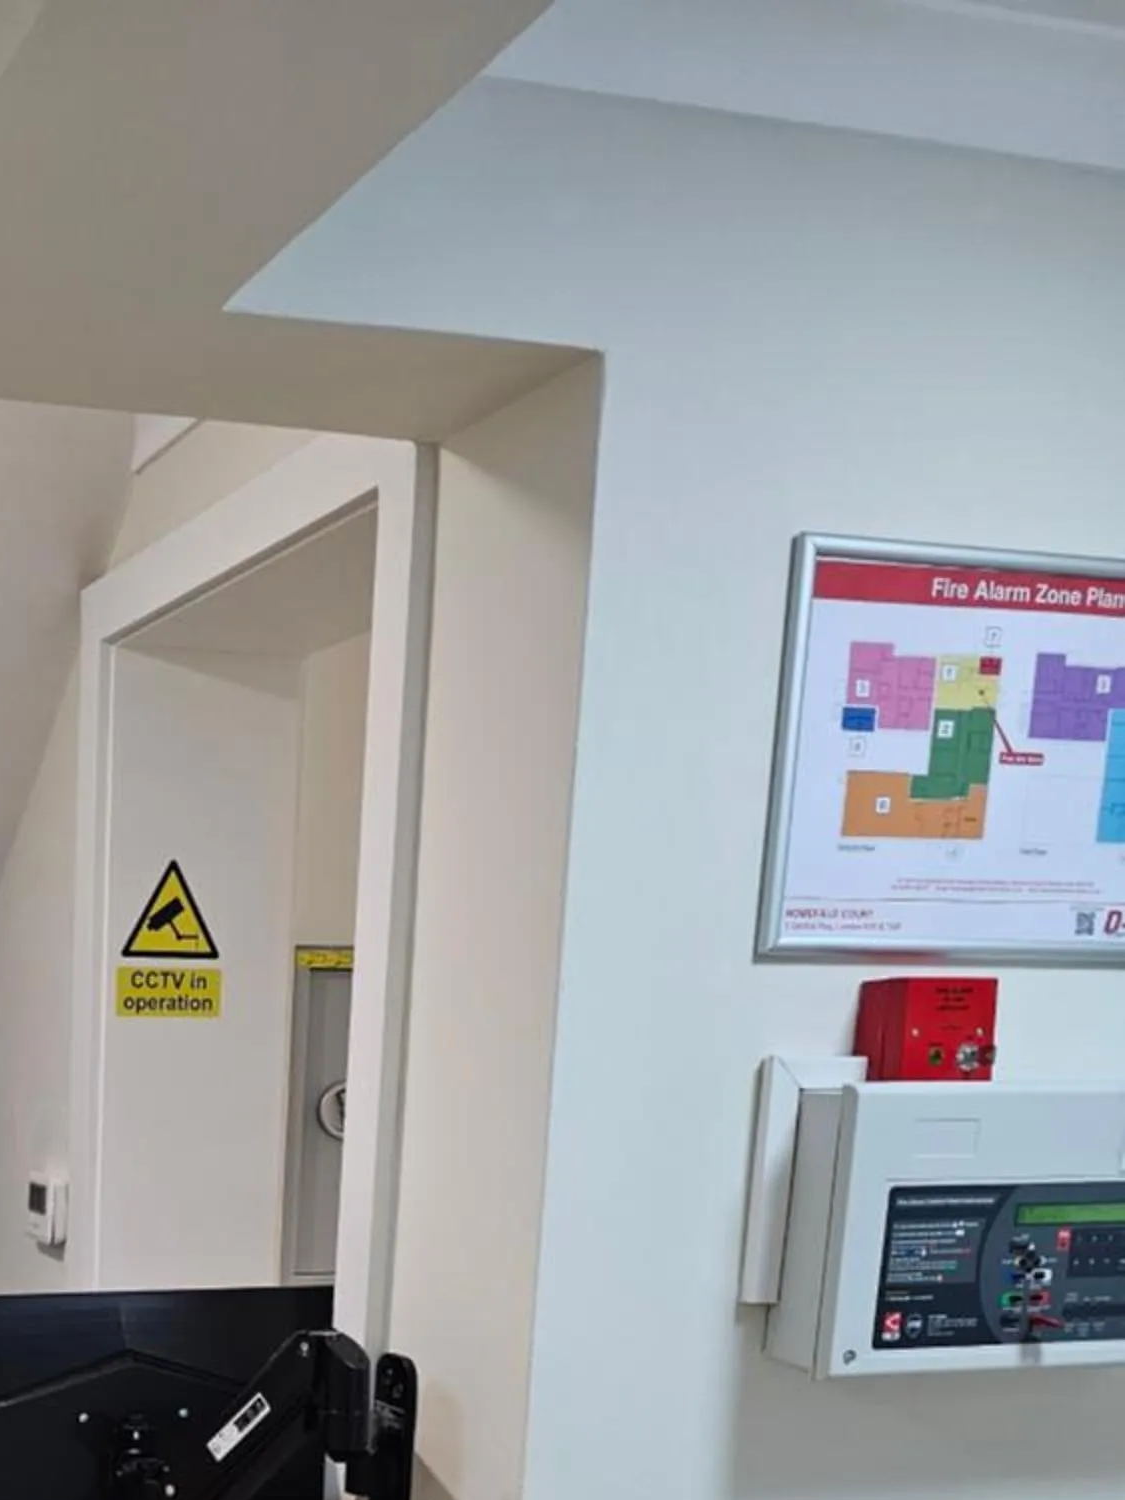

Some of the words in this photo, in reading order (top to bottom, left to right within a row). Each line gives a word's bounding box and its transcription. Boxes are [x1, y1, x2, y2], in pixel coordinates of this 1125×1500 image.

[931, 577, 969, 599] Fire
[974, 580, 1030, 602] Alarm
[1035, 584, 1082, 606] Zone
[131, 970, 186, 989] CCTV
[190, 971, 207, 989] in
[123, 994, 213, 1014] operation
